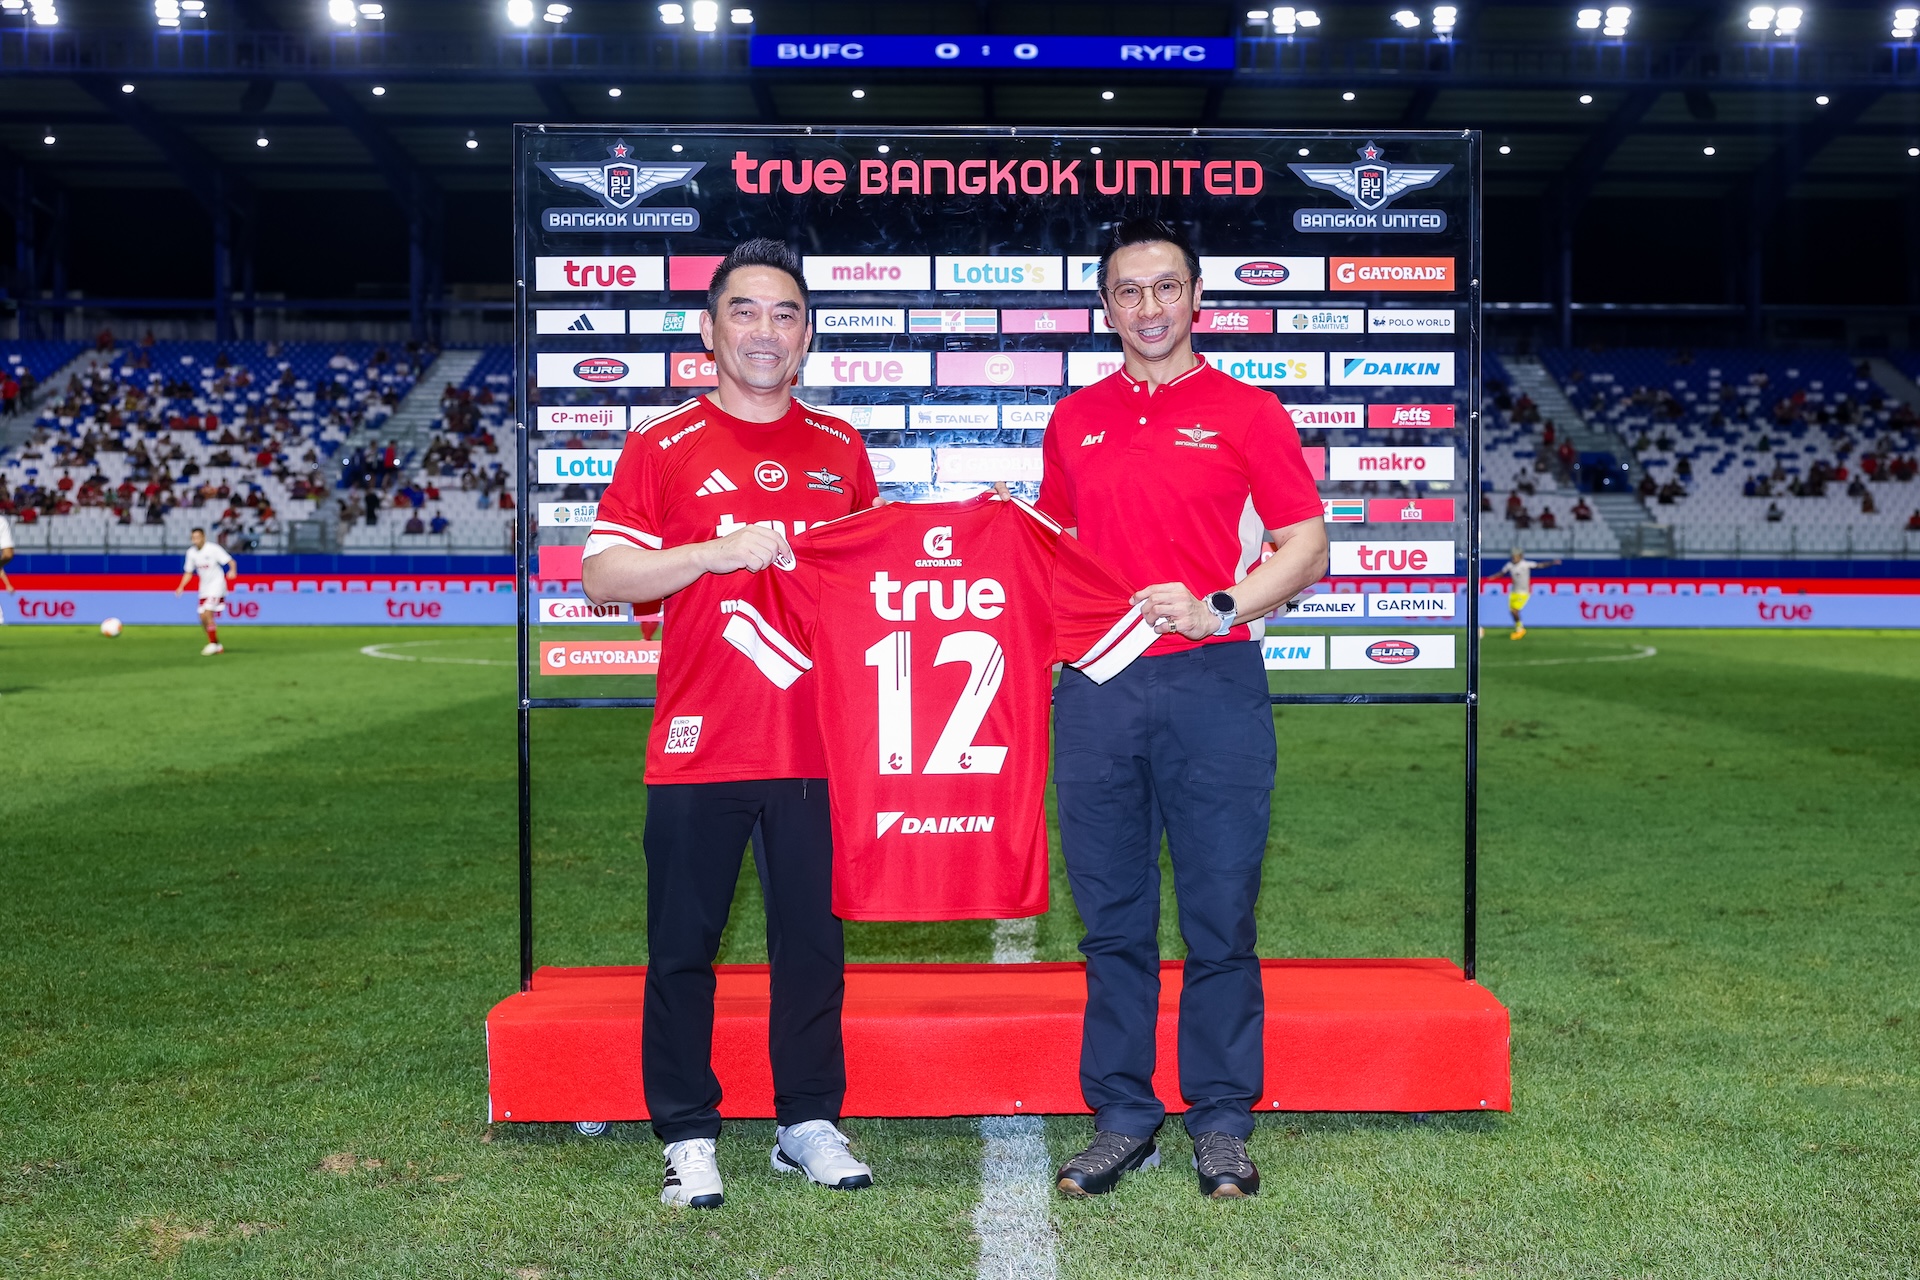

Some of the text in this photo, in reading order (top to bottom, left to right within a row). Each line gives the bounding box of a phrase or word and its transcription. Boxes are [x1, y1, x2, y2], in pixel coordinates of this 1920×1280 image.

[777, 43, 864, 60] BUFC
[1121, 44, 1206, 61] RYFC
[611, 176, 631, 187] BU
[732, 151, 1264, 196] true BANGKOK UNITED
[1361, 178, 1381, 188] BU
[611, 187, 631, 197] FC
[1361, 189, 1381, 199] FC
[550, 213, 693, 227] BANGKOK UNITED
[1301, 214, 1441, 228] BANGKOK UNITED
[564, 260, 637, 287] true
[832, 262, 902, 281] makro
[953, 263, 1045, 283] Lotus's
[1240, 270, 1285, 278] SURE
[1358, 266, 1446, 280] GATORADE
[1210, 312, 1249, 328] jetts
[831, 356, 903, 382] true
[989, 363, 1010, 376] CP
[1364, 363, 1440, 375] DAIKIN
[551, 410, 613, 426] CP-meiji
[935, 415, 989, 423] STANLEY
[1288, 409, 1356, 424] Canon
[1392, 407, 1431, 424] jetts
[805, 418, 850, 445] GARMIN
[1081, 431, 1106, 447] Ari
[556, 456, 617, 476] Lotu
[1358, 453, 1427, 471] makro
[759, 469, 783, 482] CP
[914, 559, 962, 568] GATORADE
[1358, 545, 1428, 570] true
[869, 571, 1006, 621] true
[19, 597, 76, 618] true
[386, 597, 442, 618] true
[548, 603, 620, 618] Canon
[1303, 603, 1355, 612] STANLEY
[1579, 600, 1634, 620] true
[1758, 600, 1812, 620] true
[570, 650, 659, 664] GATORADE
[864, 630, 1009, 775] 12
[671, 725, 699, 739] EURO
[668, 737, 696, 749] CAKE
[900, 816, 995, 834] DAIKIN
